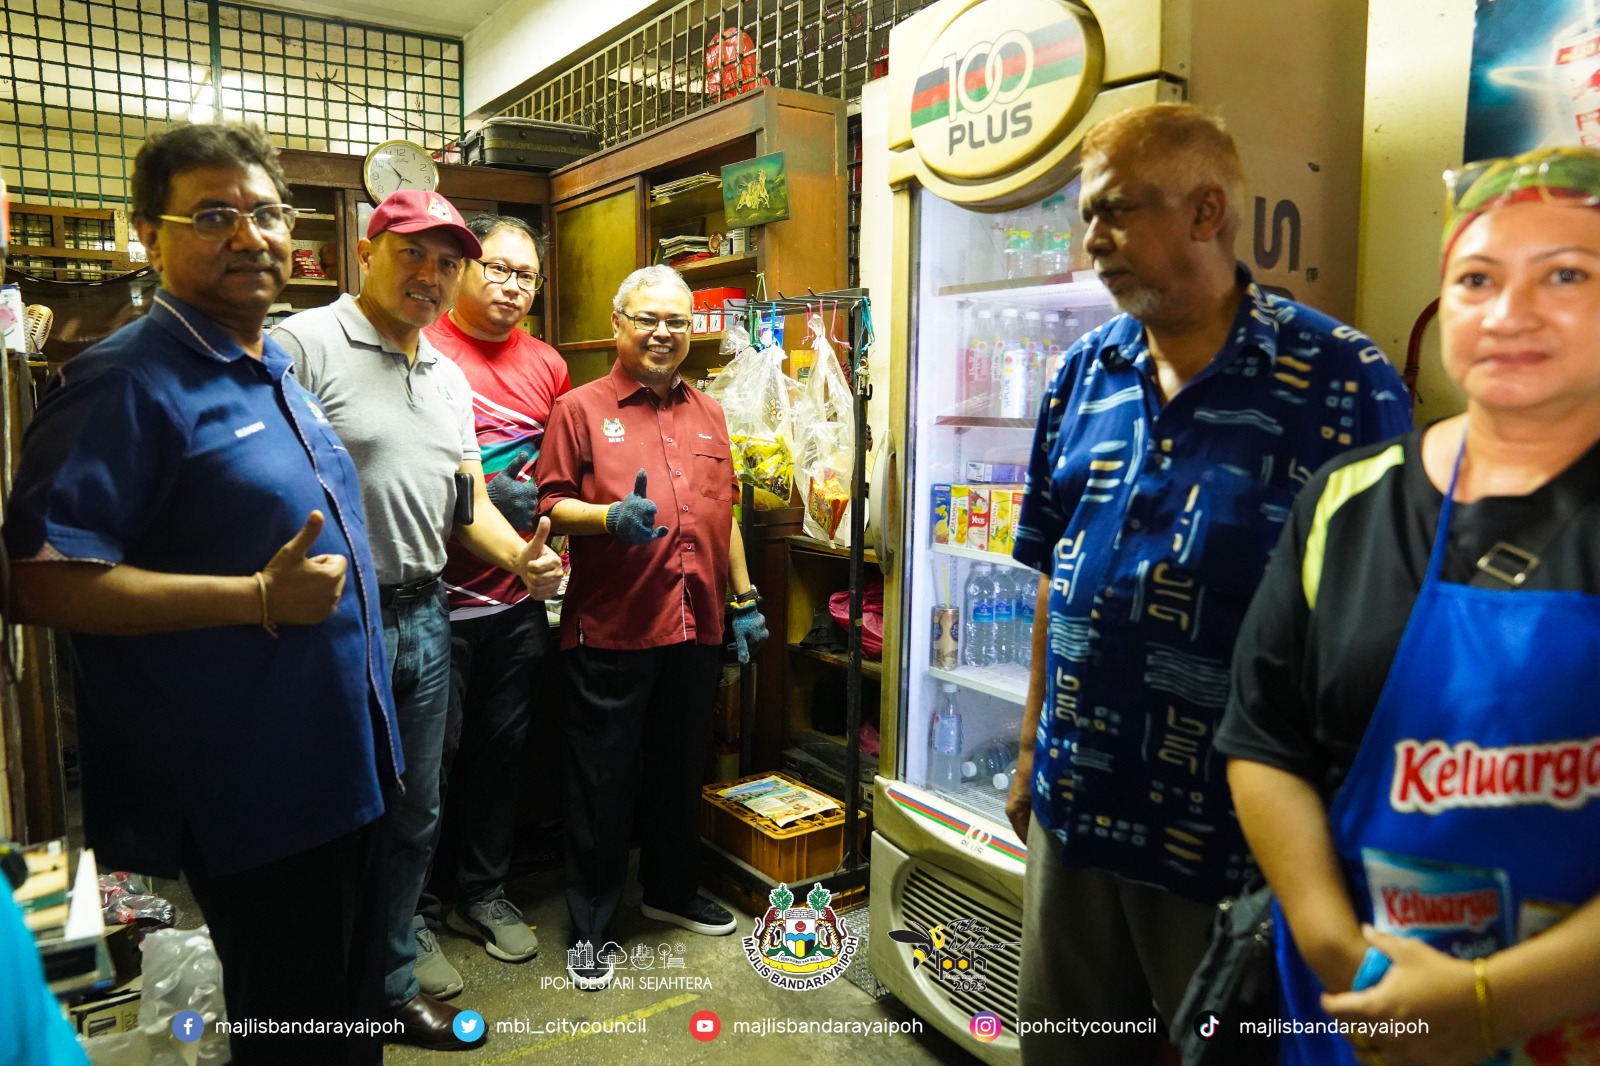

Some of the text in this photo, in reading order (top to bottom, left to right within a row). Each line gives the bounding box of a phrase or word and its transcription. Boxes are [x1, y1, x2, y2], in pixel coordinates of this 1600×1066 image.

[943, 29, 1035, 123] 100
[948, 101, 1033, 156] PLUS
[395, 148, 406, 157] 12
[419, 163, 427, 172] 2
[372, 172, 380, 180] 9
[423, 176, 432, 184] 3
[376, 185, 385, 194] 8
[960, 840, 983, 854] PLUS
